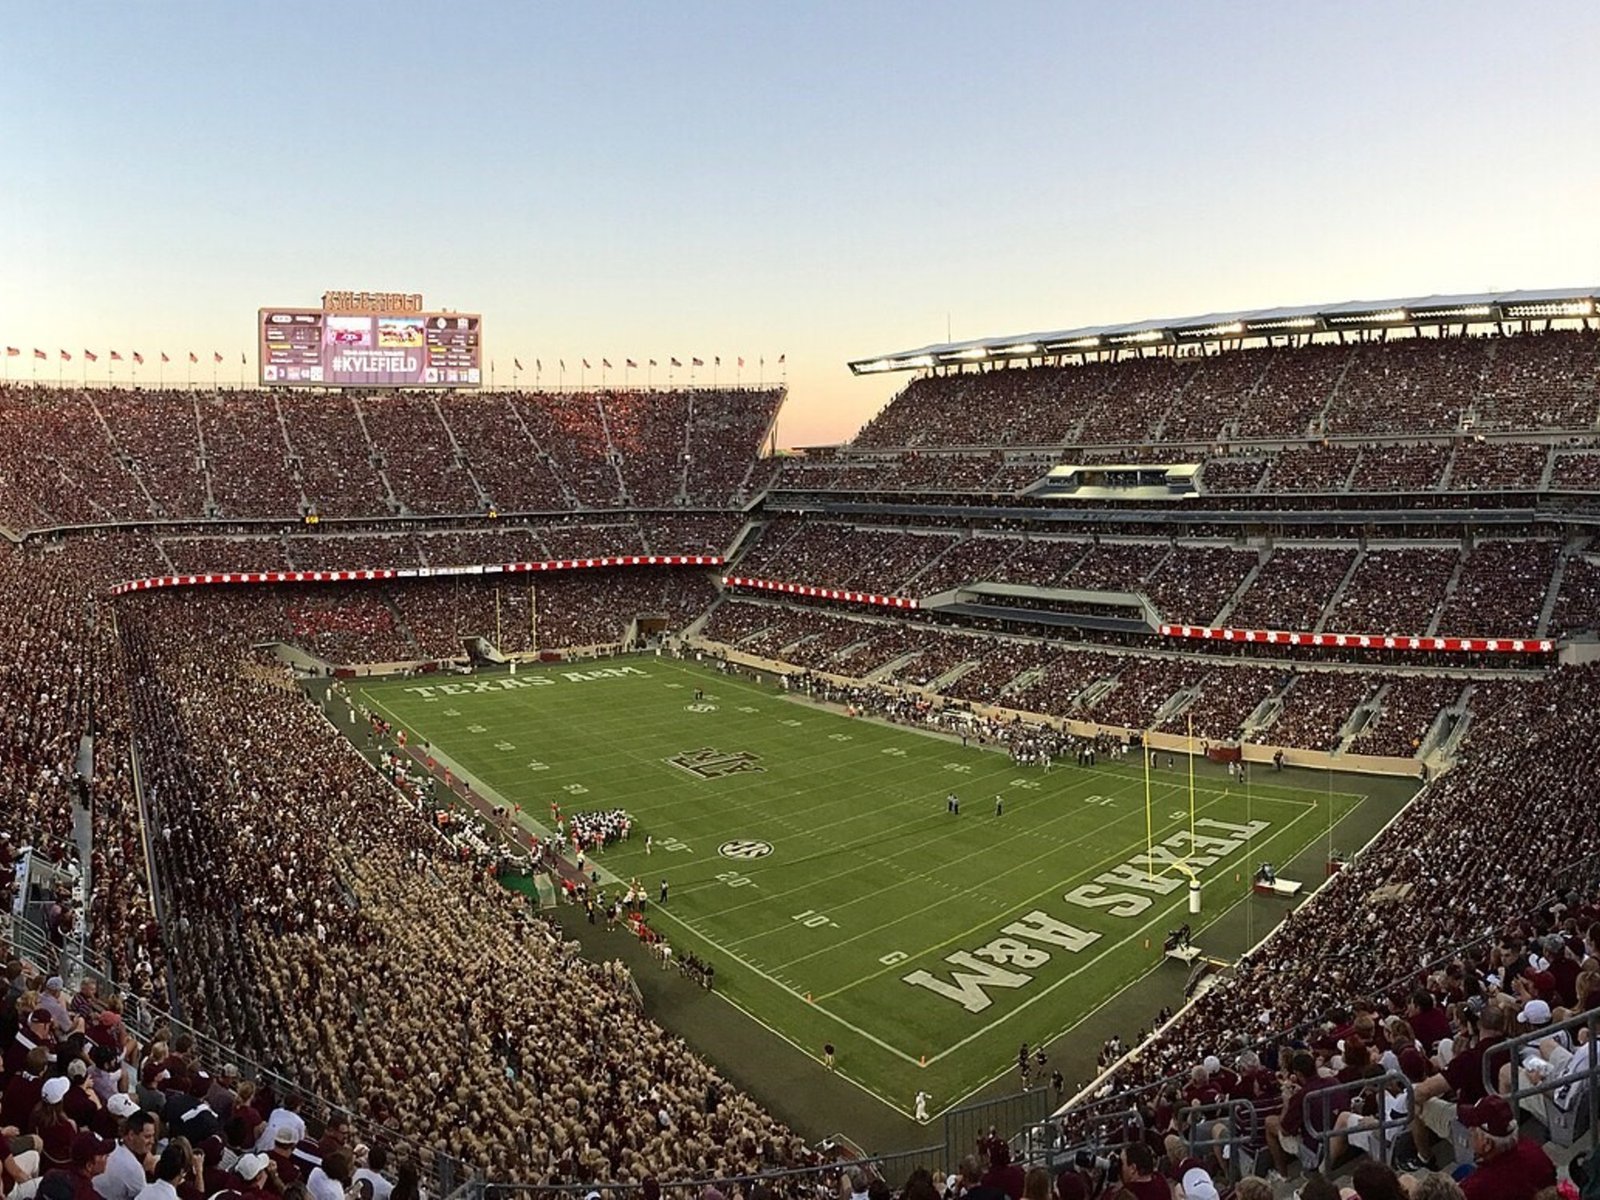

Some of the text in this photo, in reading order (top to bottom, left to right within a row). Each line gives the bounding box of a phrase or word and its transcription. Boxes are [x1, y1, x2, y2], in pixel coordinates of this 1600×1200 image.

[332, 356, 417, 373] #KYLEFIELD
[404, 675, 555, 698] TEXAS
[655, 837, 687, 852] 30
[715, 871, 751, 888] 20
[792, 909, 830, 929] 10
[901, 817, 1272, 1014] TEXAS A&M
